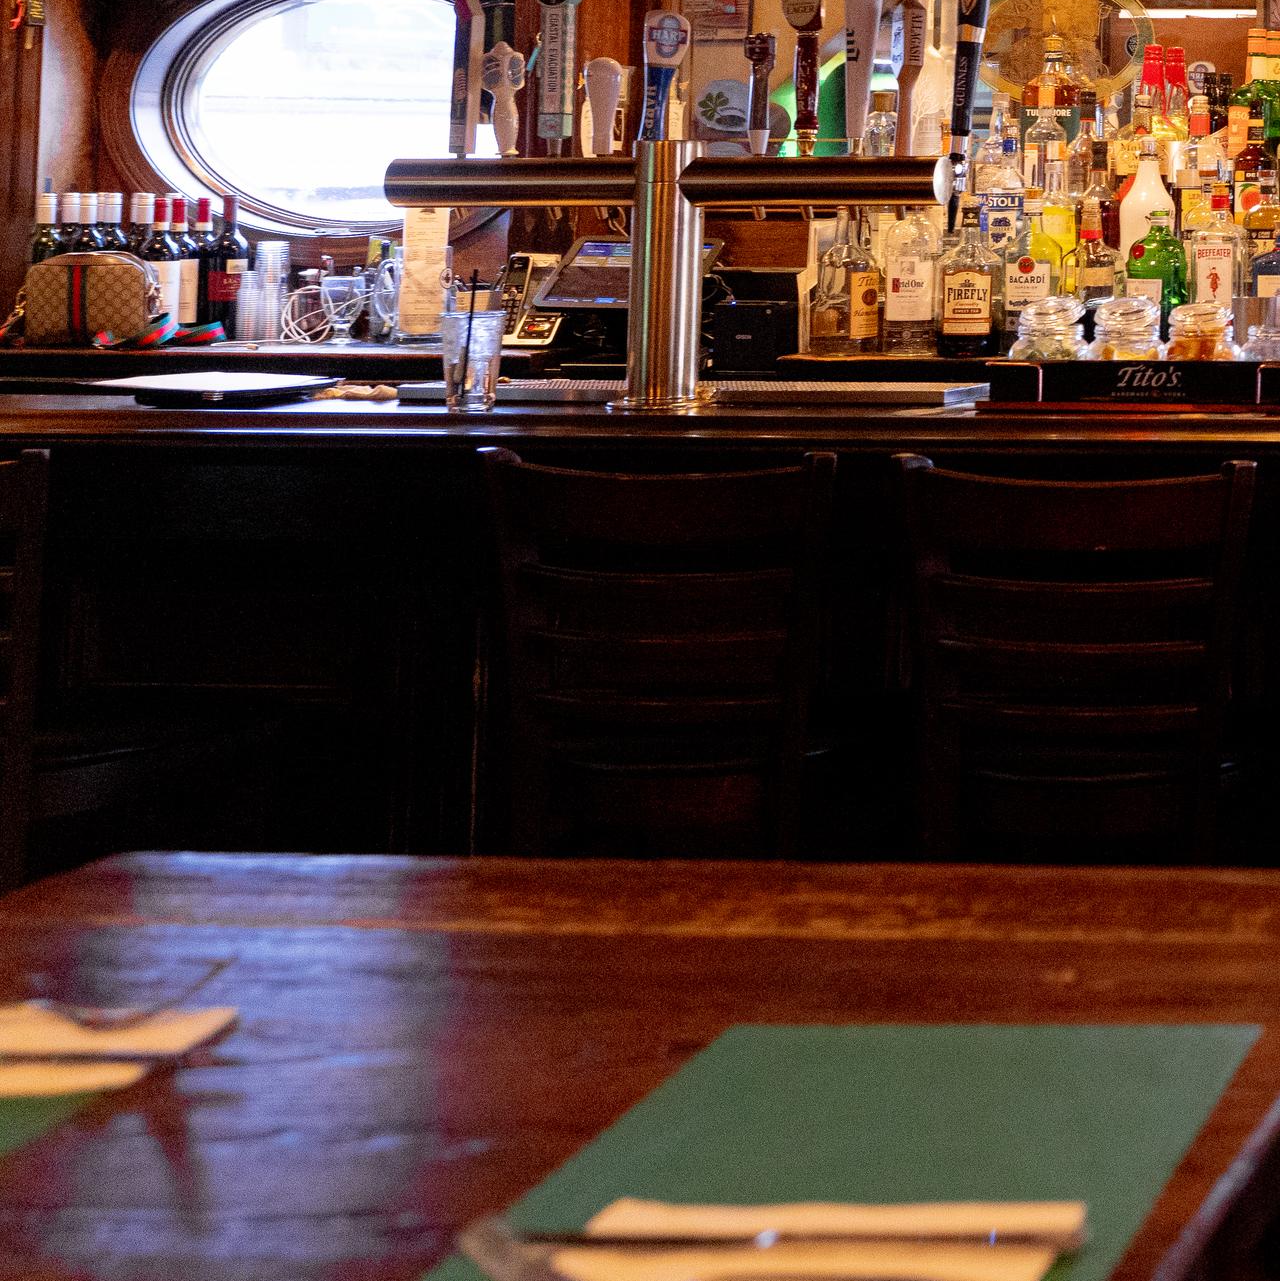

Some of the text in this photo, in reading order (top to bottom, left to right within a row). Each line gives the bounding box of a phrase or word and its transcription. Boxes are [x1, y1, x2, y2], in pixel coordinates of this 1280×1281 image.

[653, 28, 688, 42] HARP
[911, 12, 923, 64] ALLAGASH
[548, 13, 558, 93] COASTAL EVACUATION
[956, 56, 970, 107] GUINNESS
[988, 196, 1019, 209] STOLI
[1197, 247, 1232, 259] BEEFEATER
[912, 279, 925, 288] One
[1009, 274, 1046, 285] BACARDÍ
[947, 288, 988, 303] FIREFLY
[1116, 365, 1181, 388] Tito's
